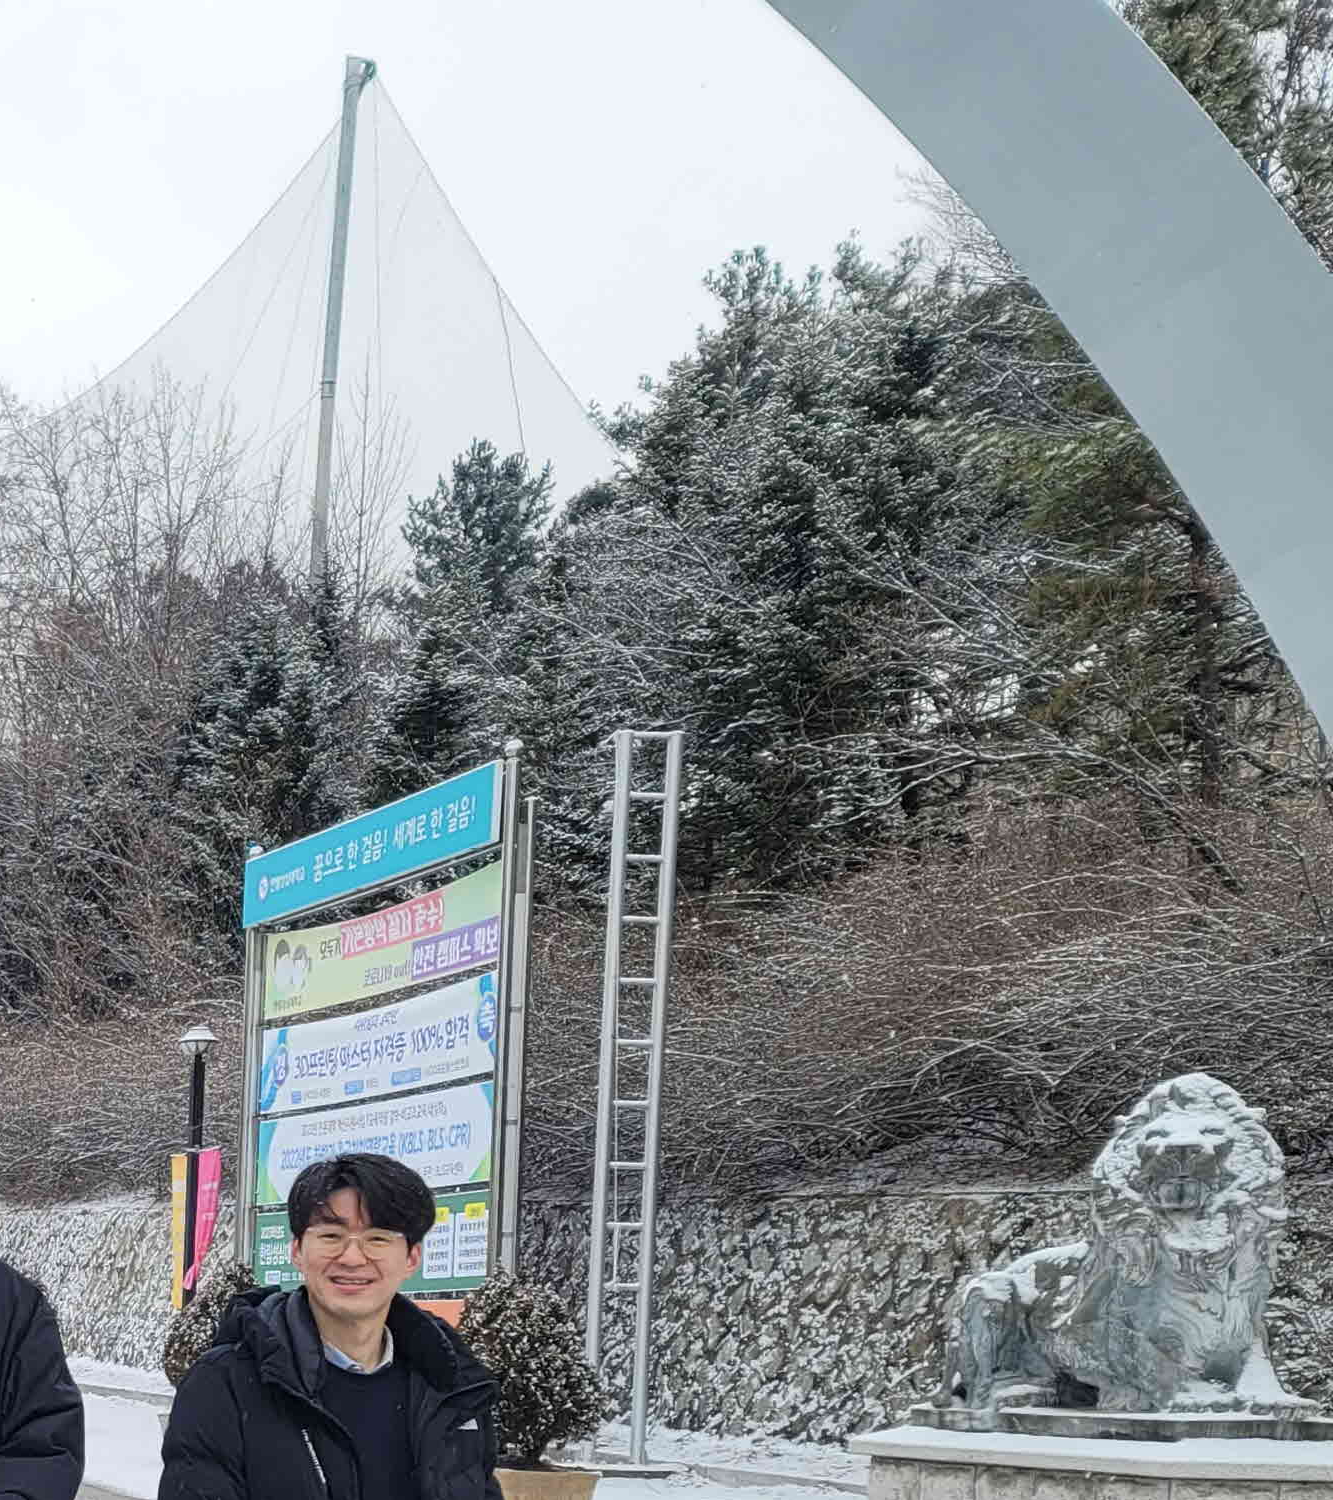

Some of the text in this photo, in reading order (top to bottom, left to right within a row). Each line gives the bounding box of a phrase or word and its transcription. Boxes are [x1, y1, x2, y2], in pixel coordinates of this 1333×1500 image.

[313, 847, 344, 883] 꿈으로
[347, 839, 358, 870] 한
[361, 828, 388, 865] 걸음!
[393, 814, 428, 850] 세계로
[430, 806, 443, 840] 한
[446, 795, 476, 833] 걸음!
[437, 934, 472, 969] 캠퍼스
[374, 1031, 407, 1064] 자격증
[411, 1023, 444, 1055] 100%
[445, 1014, 470, 1050] 합격
